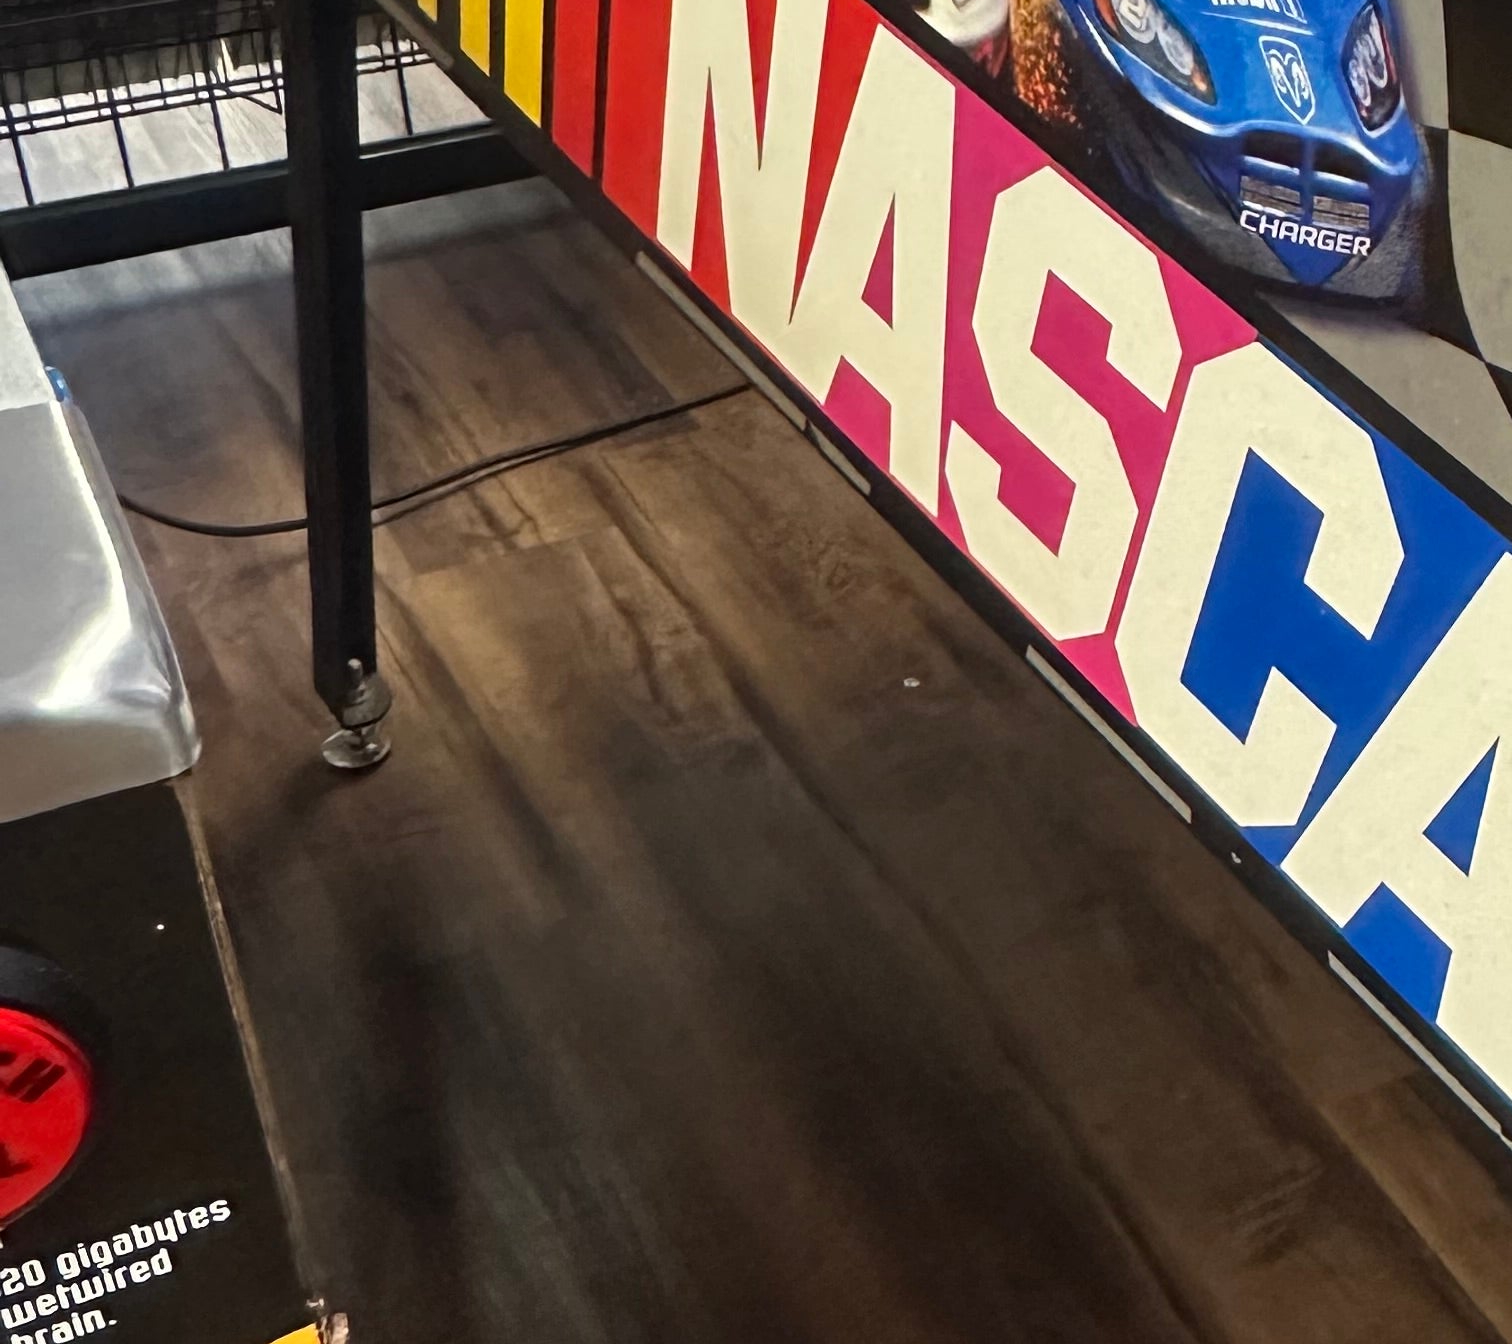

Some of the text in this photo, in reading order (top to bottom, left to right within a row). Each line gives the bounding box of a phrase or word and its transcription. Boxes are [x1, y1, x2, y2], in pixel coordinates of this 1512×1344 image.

[1239, 209, 1371, 256] CHARGER
[56, 1199, 231, 1280] gigabytes
[1, 1247, 173, 1329] wetwired
